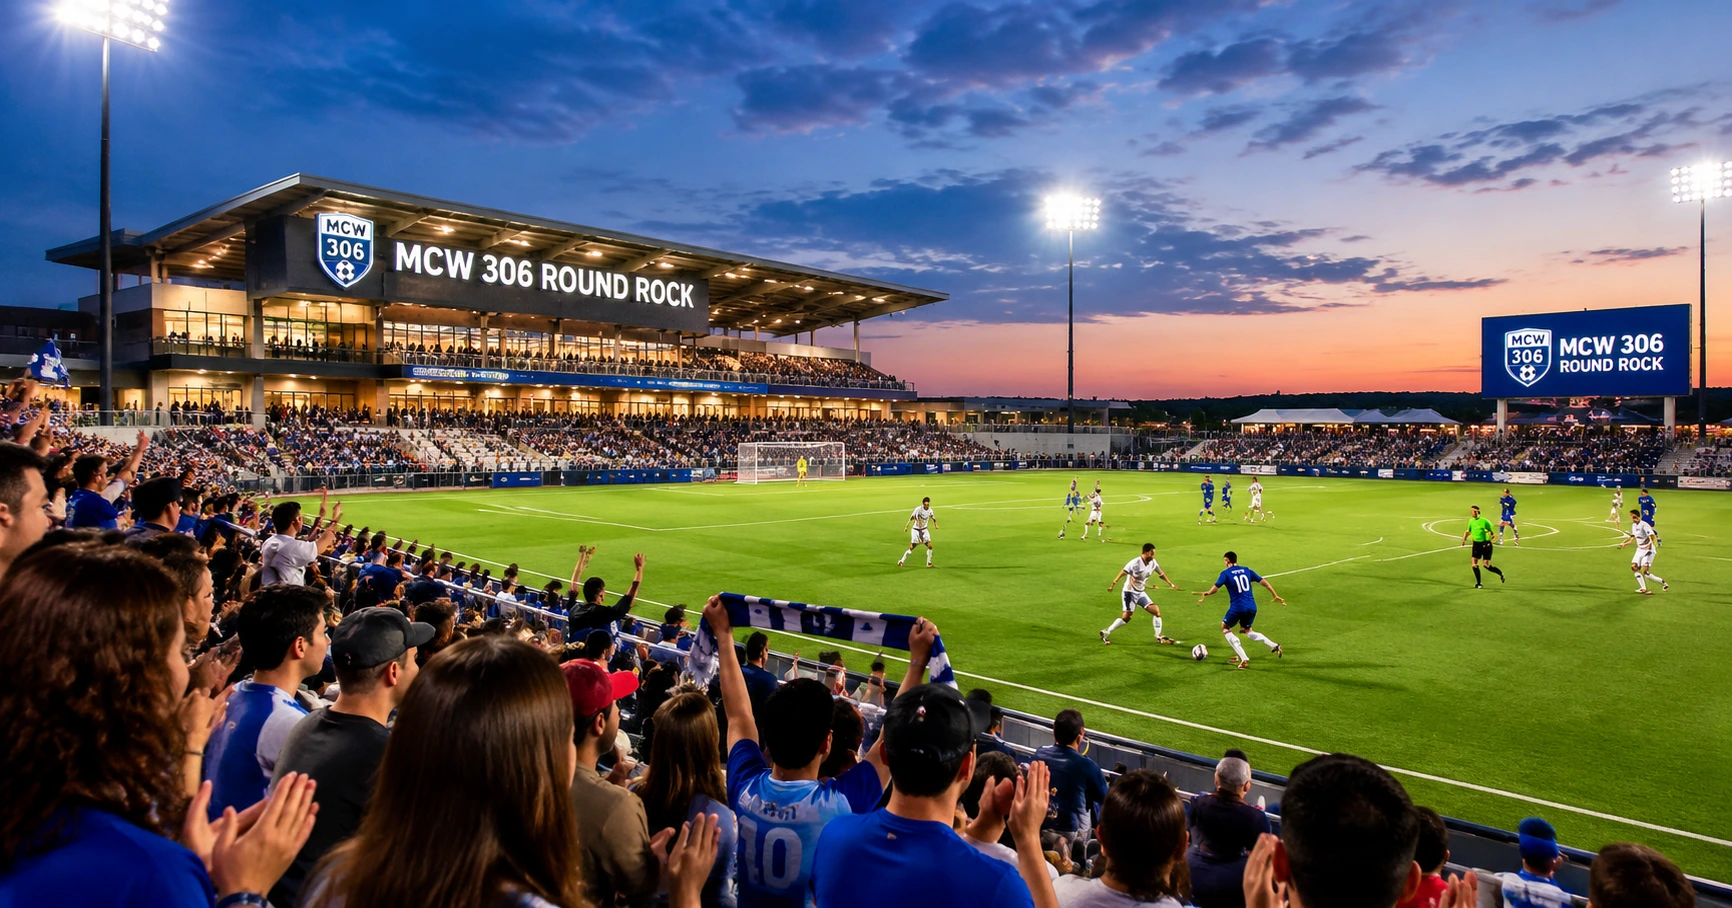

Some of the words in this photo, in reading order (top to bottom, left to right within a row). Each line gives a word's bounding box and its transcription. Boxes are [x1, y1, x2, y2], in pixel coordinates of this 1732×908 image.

[326, 218, 366, 237] MCW
[326, 239, 365, 261] 306
[395, 241, 475, 281] MCW
[481, 254, 533, 288] 306
[541, 263, 628, 301] ROUND
[635, 276, 694, 309] ROCK
[1511, 334, 1545, 346] MCW
[1560, 335, 1615, 356] MCW
[1620, 333, 1664, 354] 306
[1511, 349, 1544, 364] 306
[1560, 358, 1614, 373] ROUND
[1618, 356, 1664, 372] ROCK
[1233, 574, 1250, 594] 10
[739, 815, 802, 890] 10
